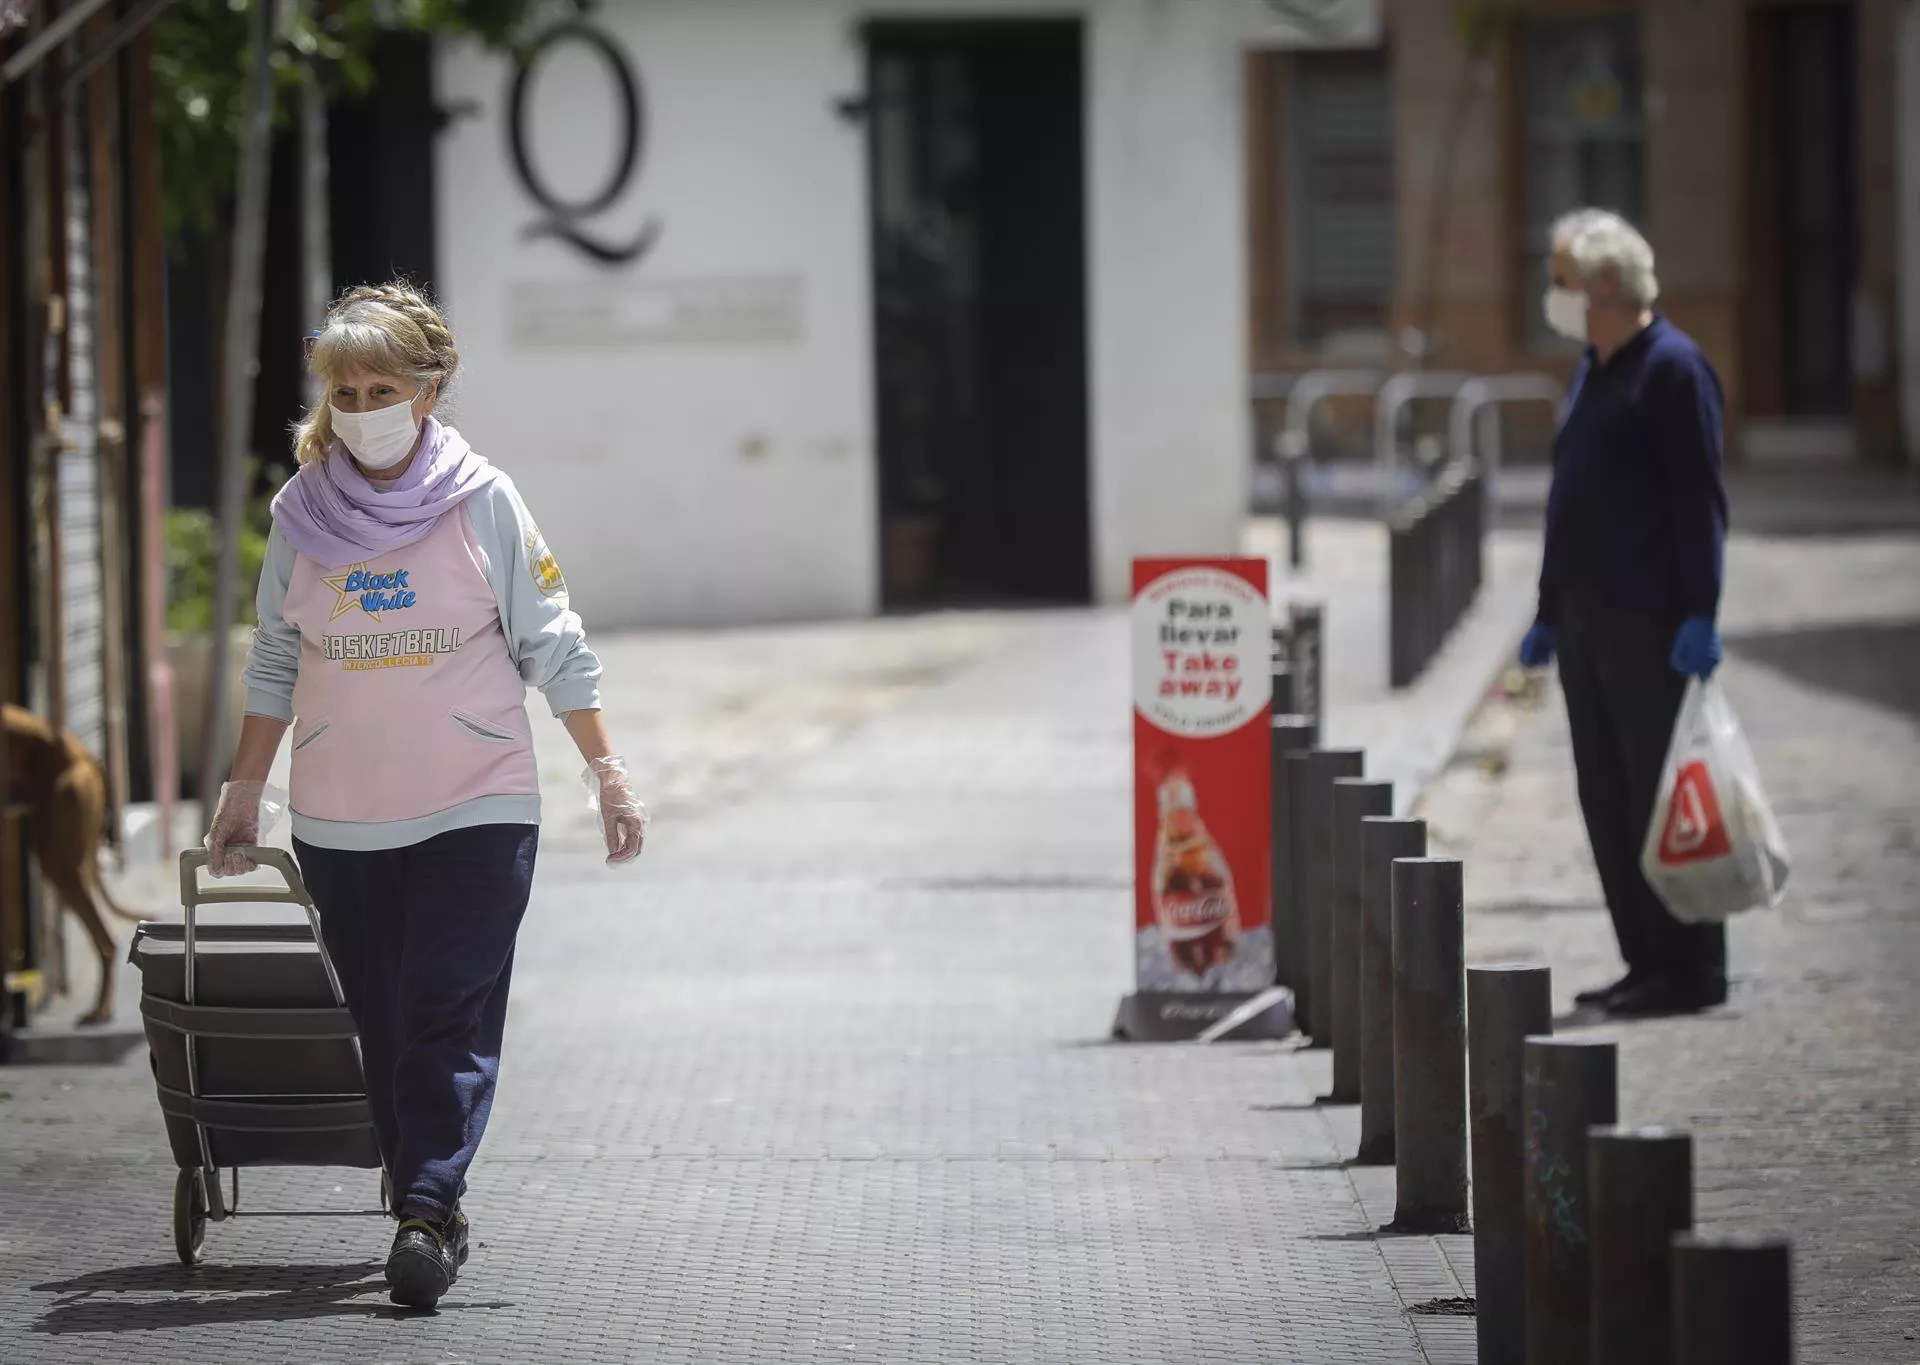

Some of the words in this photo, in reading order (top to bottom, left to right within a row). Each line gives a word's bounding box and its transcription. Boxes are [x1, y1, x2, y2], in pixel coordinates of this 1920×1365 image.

[508, 20, 662, 266] Q
[345, 569, 409, 592] Black
[360, 588, 416, 612] White
[1167, 600, 1233, 619] Para
[322, 628, 463, 660] BASKETBALL
[1160, 624, 1241, 644] llevar
[342, 655, 434, 671] INTERCOLLEGIATE
[1161, 650, 1238, 672] Take
[1158, 679, 1242, 702] away
